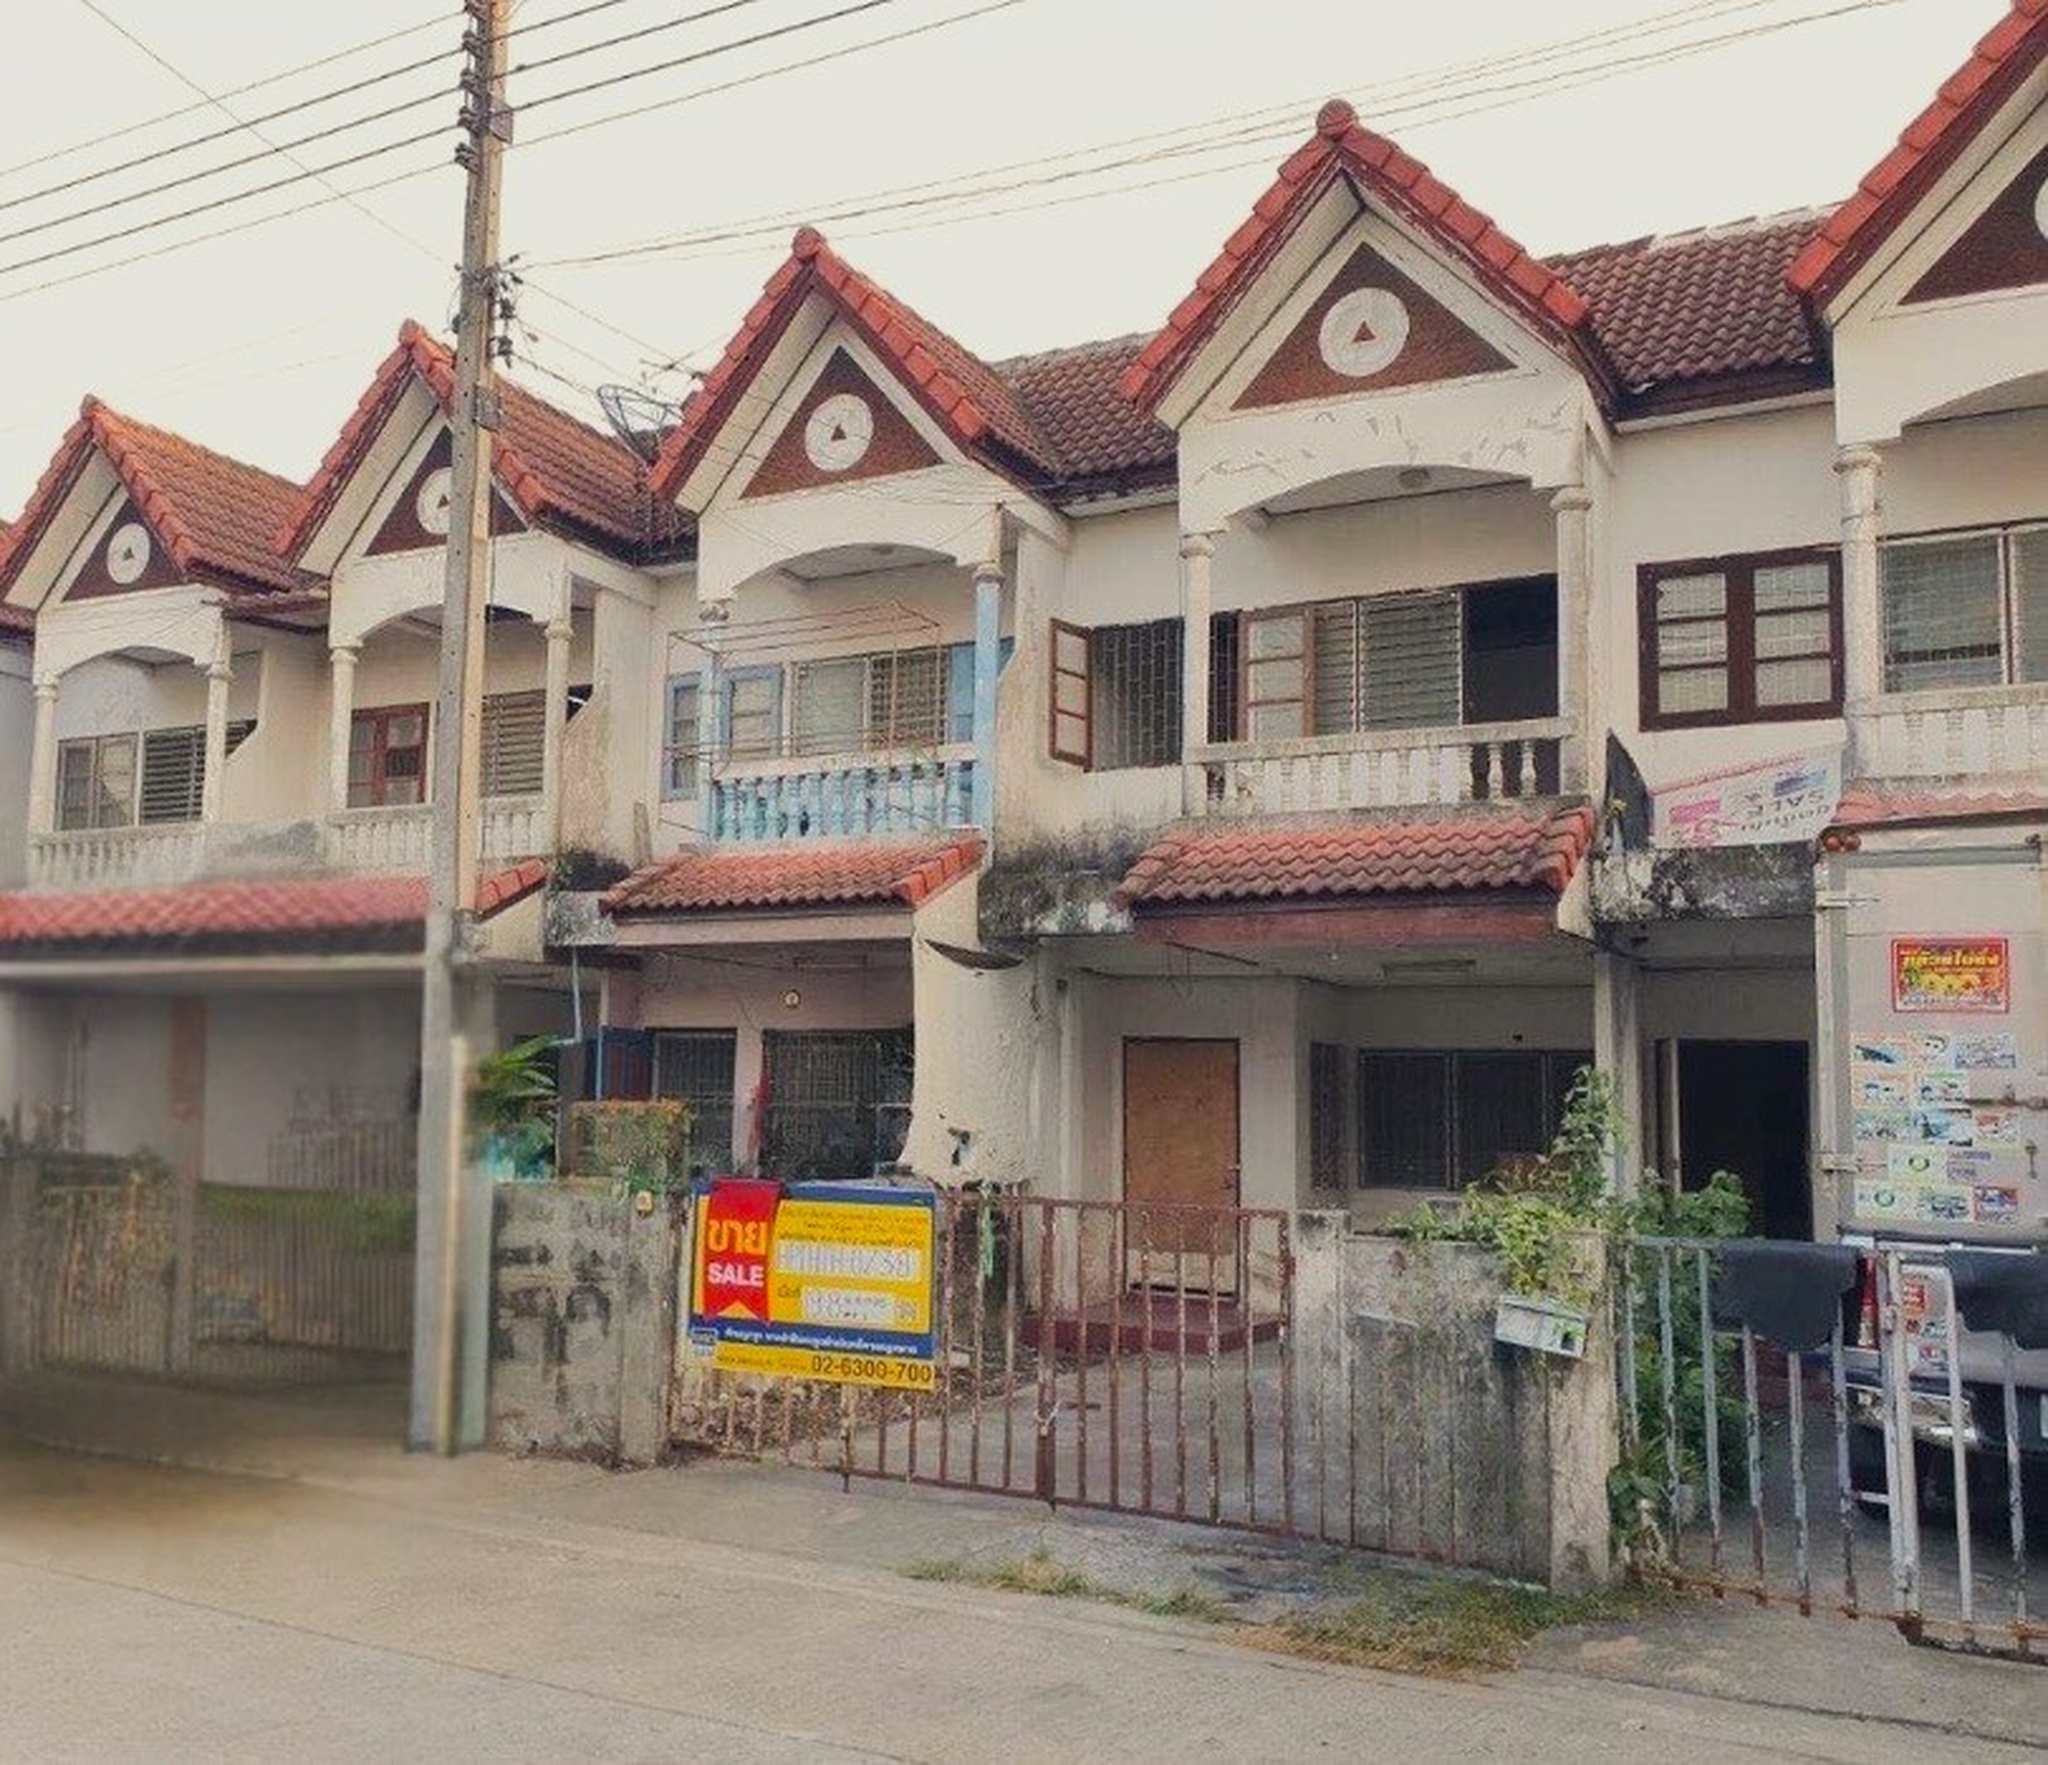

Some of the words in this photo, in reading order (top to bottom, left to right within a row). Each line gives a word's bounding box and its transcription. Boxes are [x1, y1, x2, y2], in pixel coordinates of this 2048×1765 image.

[708, 1219, 768, 1255] ขาย
[707, 1262, 764, 1287] SALE
[811, 1355, 932, 1383] 02-6300-700
